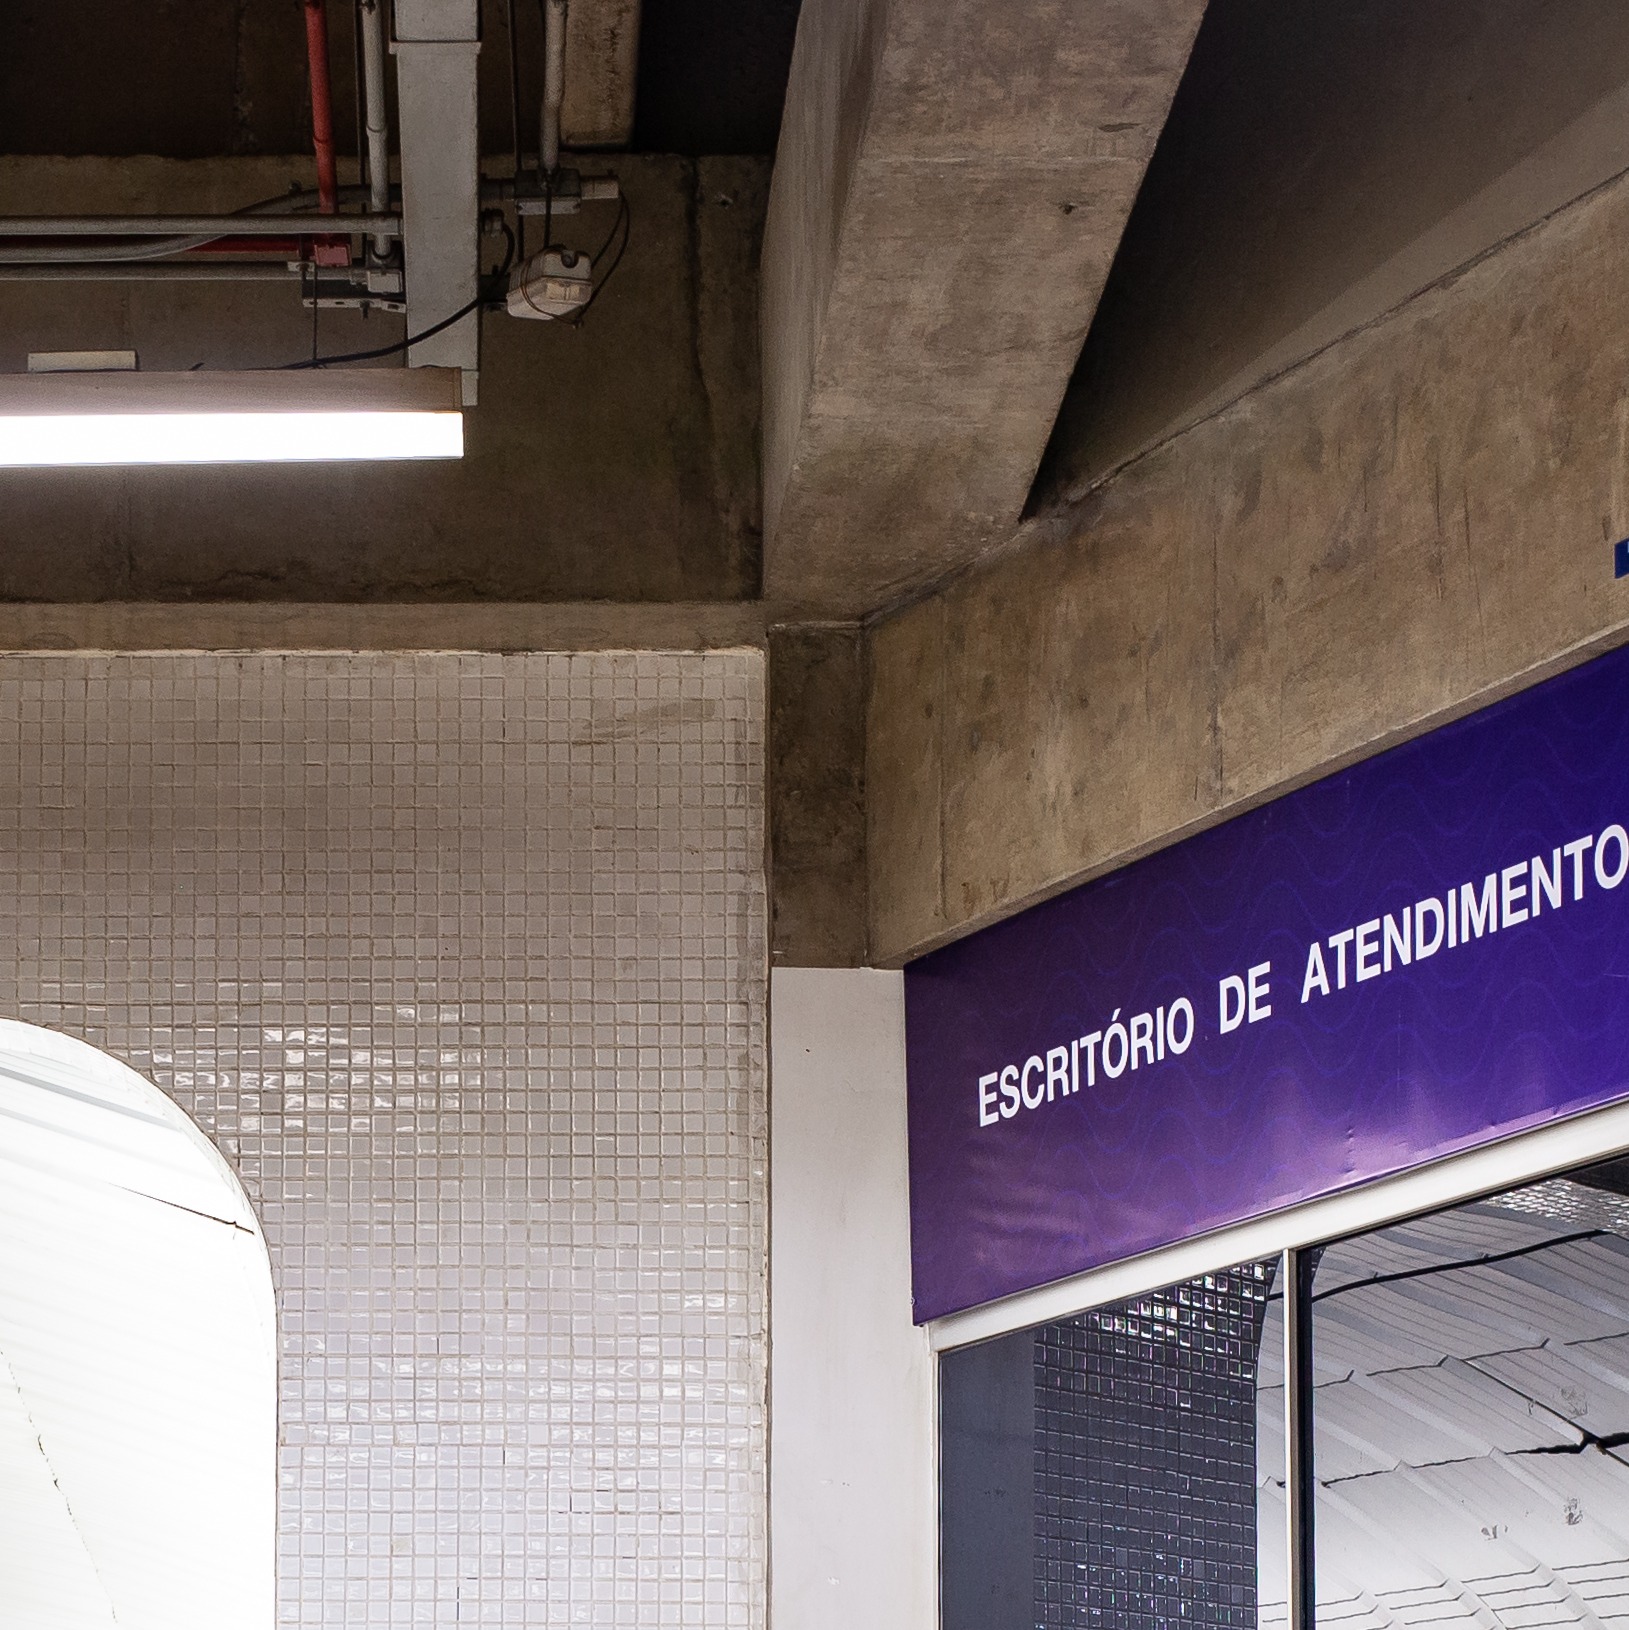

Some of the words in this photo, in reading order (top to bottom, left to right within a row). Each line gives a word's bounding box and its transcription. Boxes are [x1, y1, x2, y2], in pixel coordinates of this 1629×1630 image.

[979, 997, 1194, 1127] ESCRITÓRIO
[1219, 961, 1271, 1034] DE
[1301, 824, 1629, 1003] ATENDIMENTO
